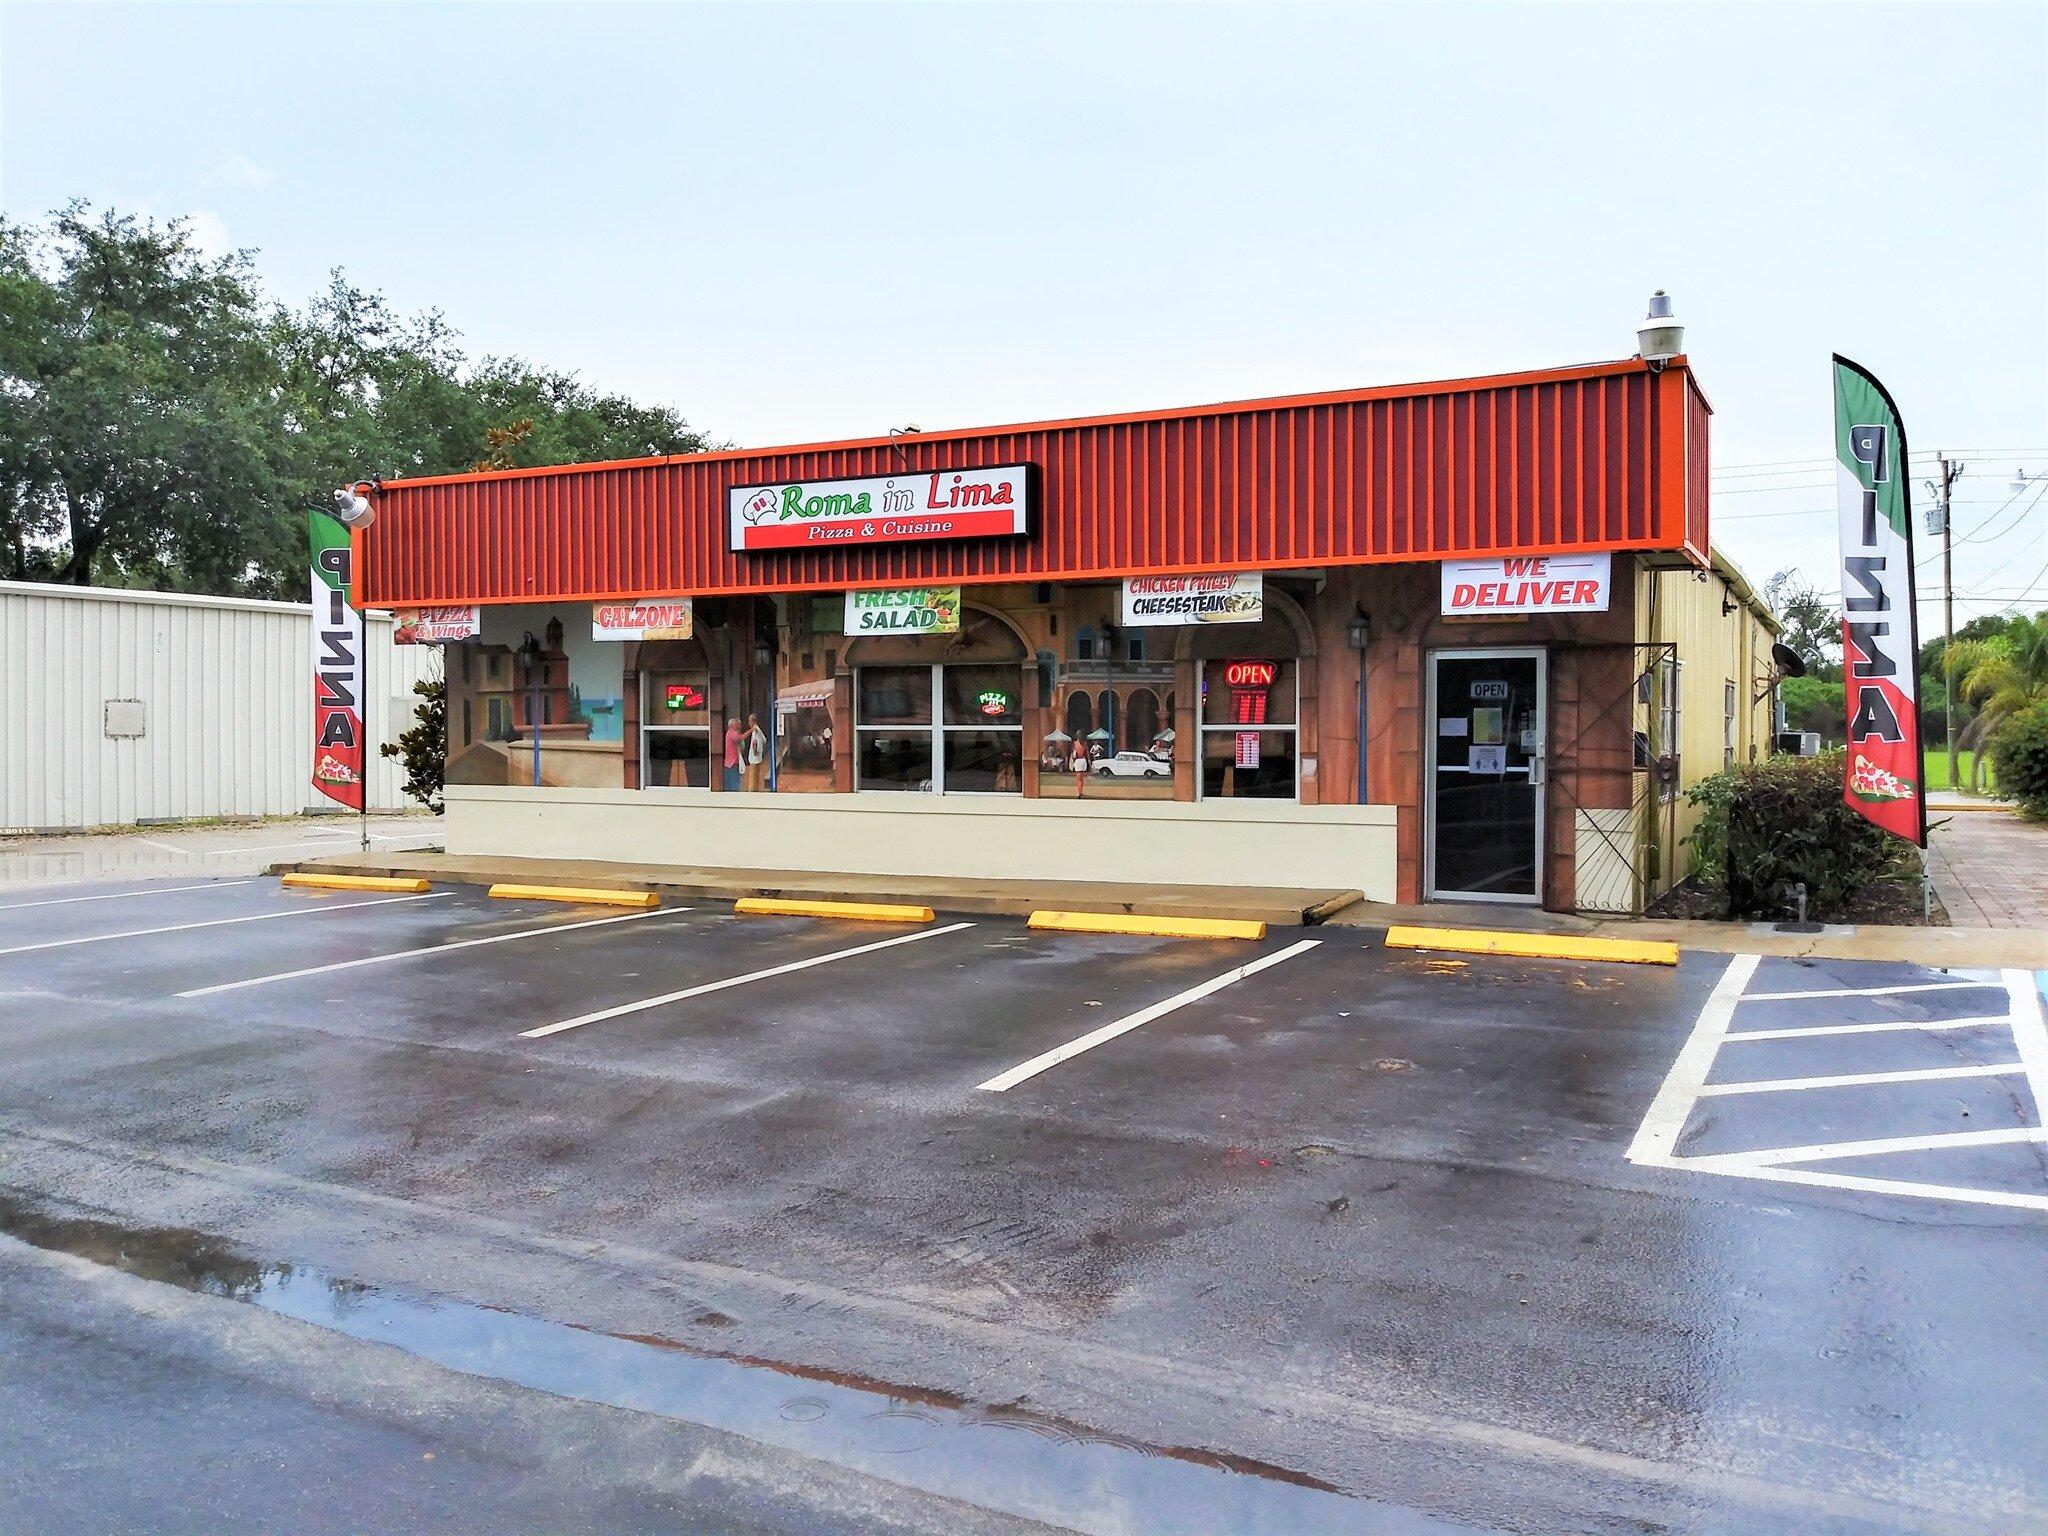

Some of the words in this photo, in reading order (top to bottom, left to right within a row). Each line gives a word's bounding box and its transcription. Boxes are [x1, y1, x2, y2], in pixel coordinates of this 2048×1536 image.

[779, 485, 872, 520] Roma
[883, 480, 914, 513] in
[927, 473, 1014, 509] Lima
[807, 525, 854, 540] Pizza
[861, 522, 875, 537] &
[882, 519, 953, 536] Cuisine
[1503, 556, 1549, 578] WE
[1129, 576, 1185, 595] CHICKEN
[1189, 573, 1238, 592] PHILLY
[1451, 580, 1600, 608] DELIVER
[855, 589, 926, 609] FRESH
[1133, 595, 1227, 615] CHEESESTEAK
[416, 605, 474, 624] PIZZA
[599, 605, 685, 629] CALZONE
[860, 609, 937, 630] SALAD
[431, 625, 472, 640] Wings
[1228, 665, 1273, 684] OPEN
[980, 692, 1006, 706] PIZZA
[1474, 684, 1505, 697] OPEN
